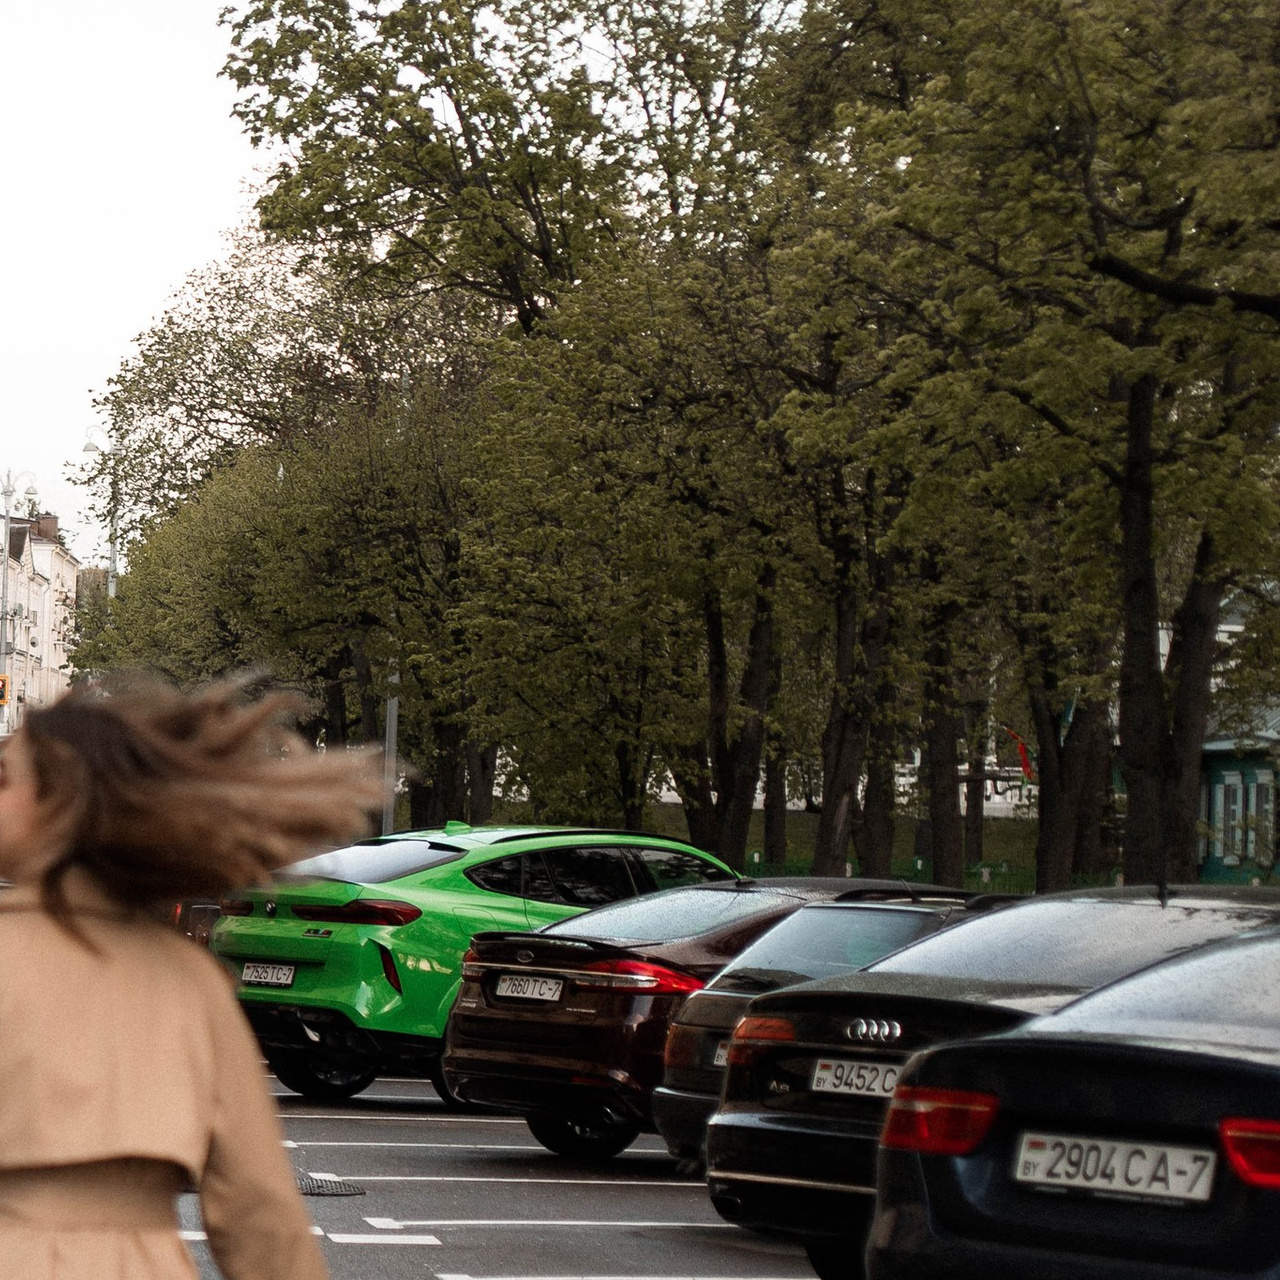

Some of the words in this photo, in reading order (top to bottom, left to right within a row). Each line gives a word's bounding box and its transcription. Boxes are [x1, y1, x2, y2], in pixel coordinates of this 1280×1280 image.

[249, 965, 270, 980] 7525
[271, 966, 293, 982] TC-7
[505, 977, 530, 995] 7660
[531, 978, 561, 999] TC-7
[816, 1077, 828, 1088] BY
[832, 1064, 880, 1093] 9452
[1022, 1160, 1039, 1177] BY
[1045, 1140, 1117, 1185] 2904
[1124, 1148, 1210, 1194] CA-7
